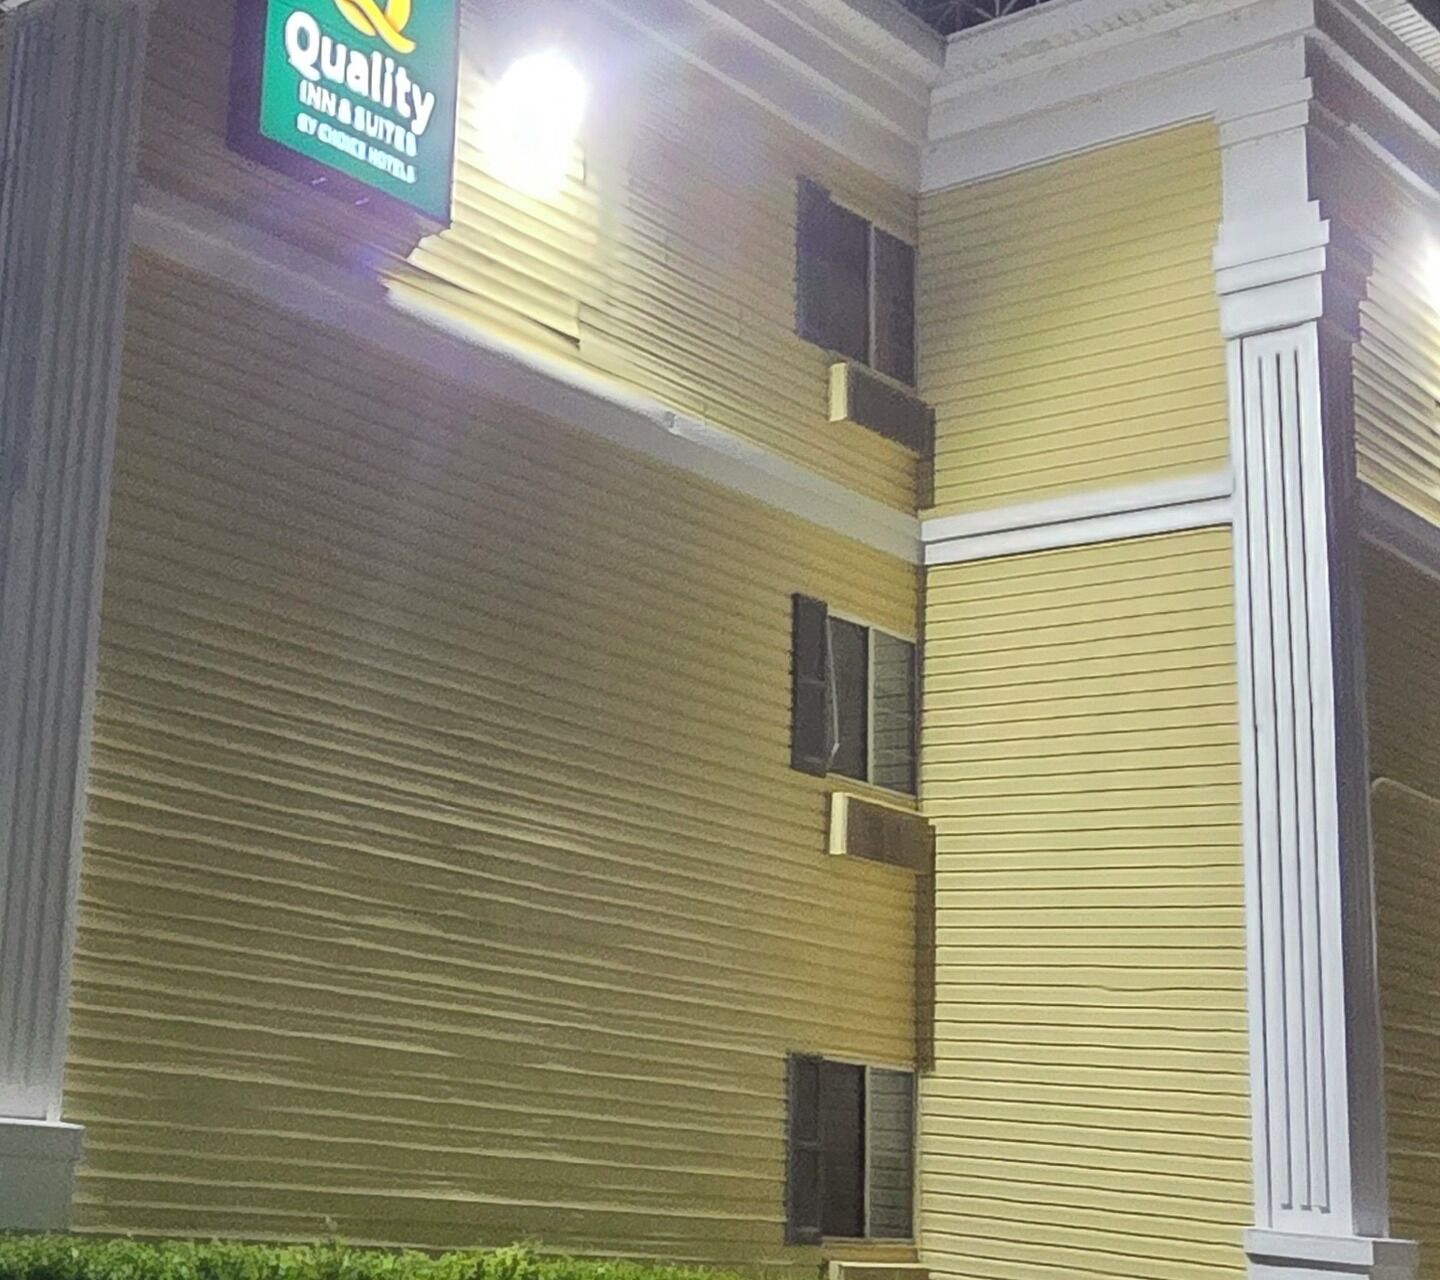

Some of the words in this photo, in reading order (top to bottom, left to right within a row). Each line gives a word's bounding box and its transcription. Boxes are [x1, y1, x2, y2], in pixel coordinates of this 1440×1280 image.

[285, 11, 435, 135] Quality
[296, 112, 318, 136] BY
[368, 146, 416, 184] HOTELS
[298, 79, 337, 117] INN
[337, 98, 352, 125] &
[353, 105, 417, 157] SUITES
